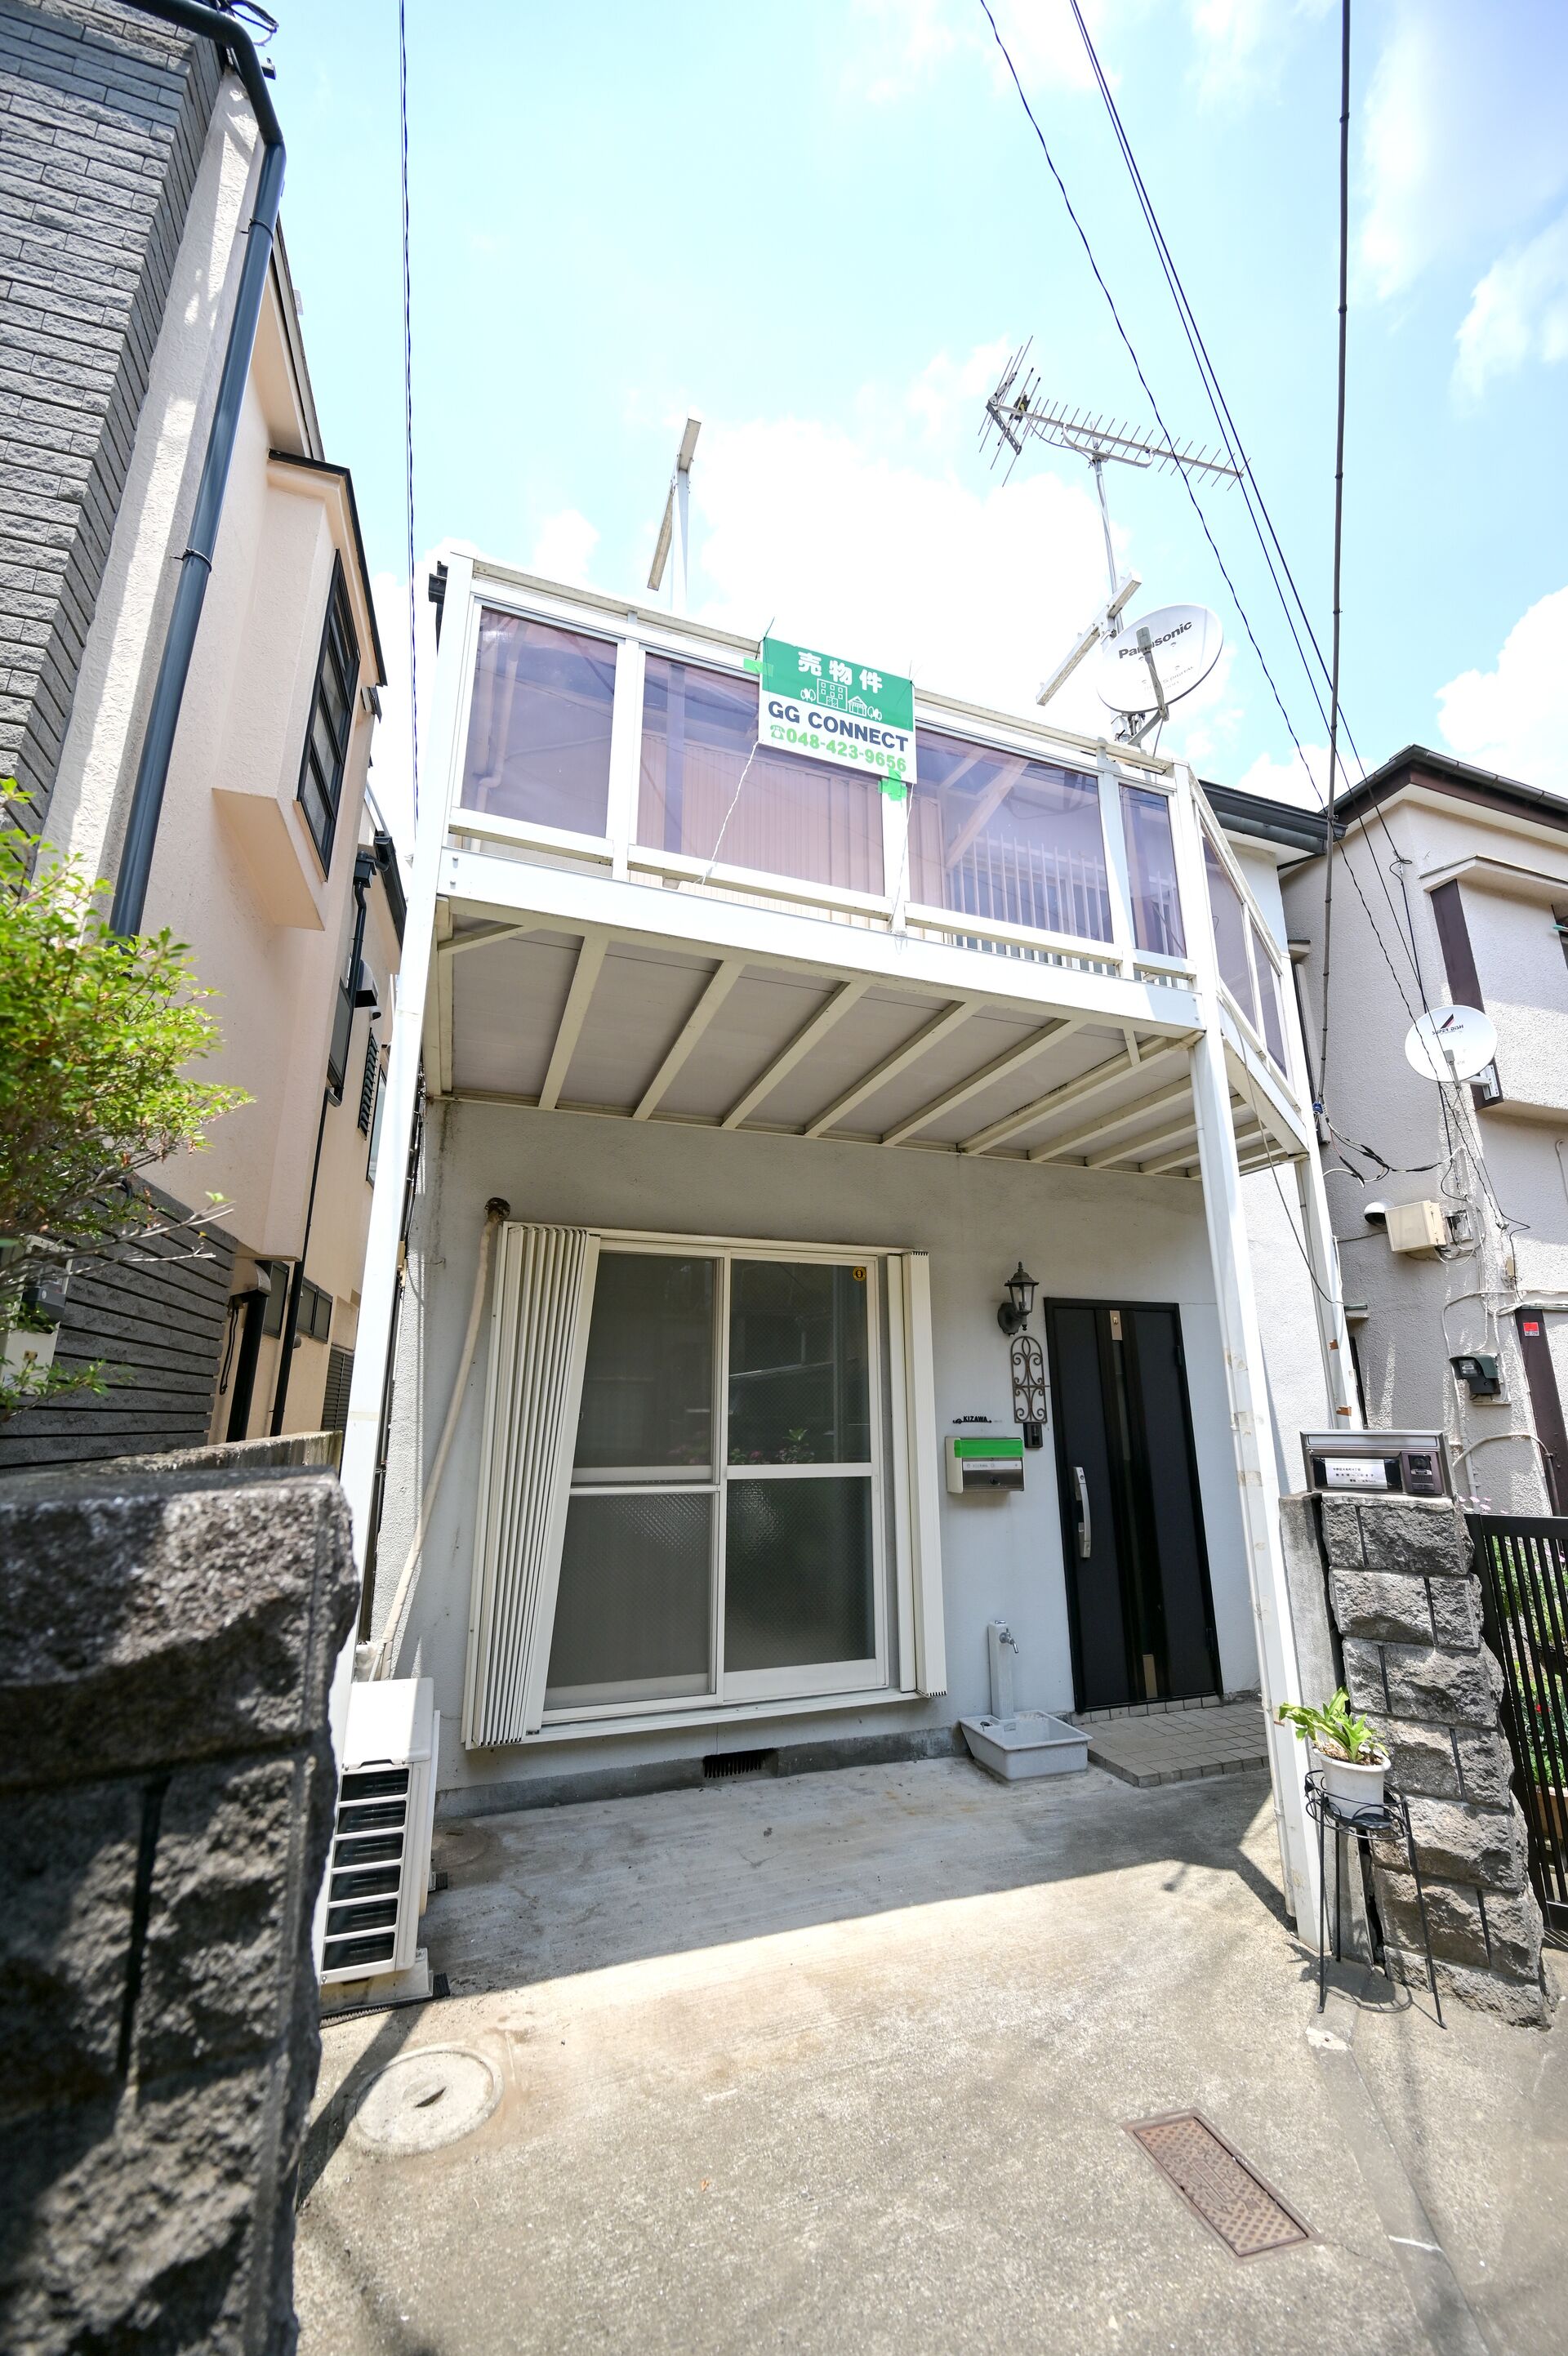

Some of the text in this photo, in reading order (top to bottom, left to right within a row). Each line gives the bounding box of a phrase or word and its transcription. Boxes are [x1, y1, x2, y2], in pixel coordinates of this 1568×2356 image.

[1118, 621, 1192, 659] Pasonic
[798, 651, 883, 693] 売物件
[768, 701, 909, 752] GG CONNECT
[786, 728, 906, 772] 048-423-9656
